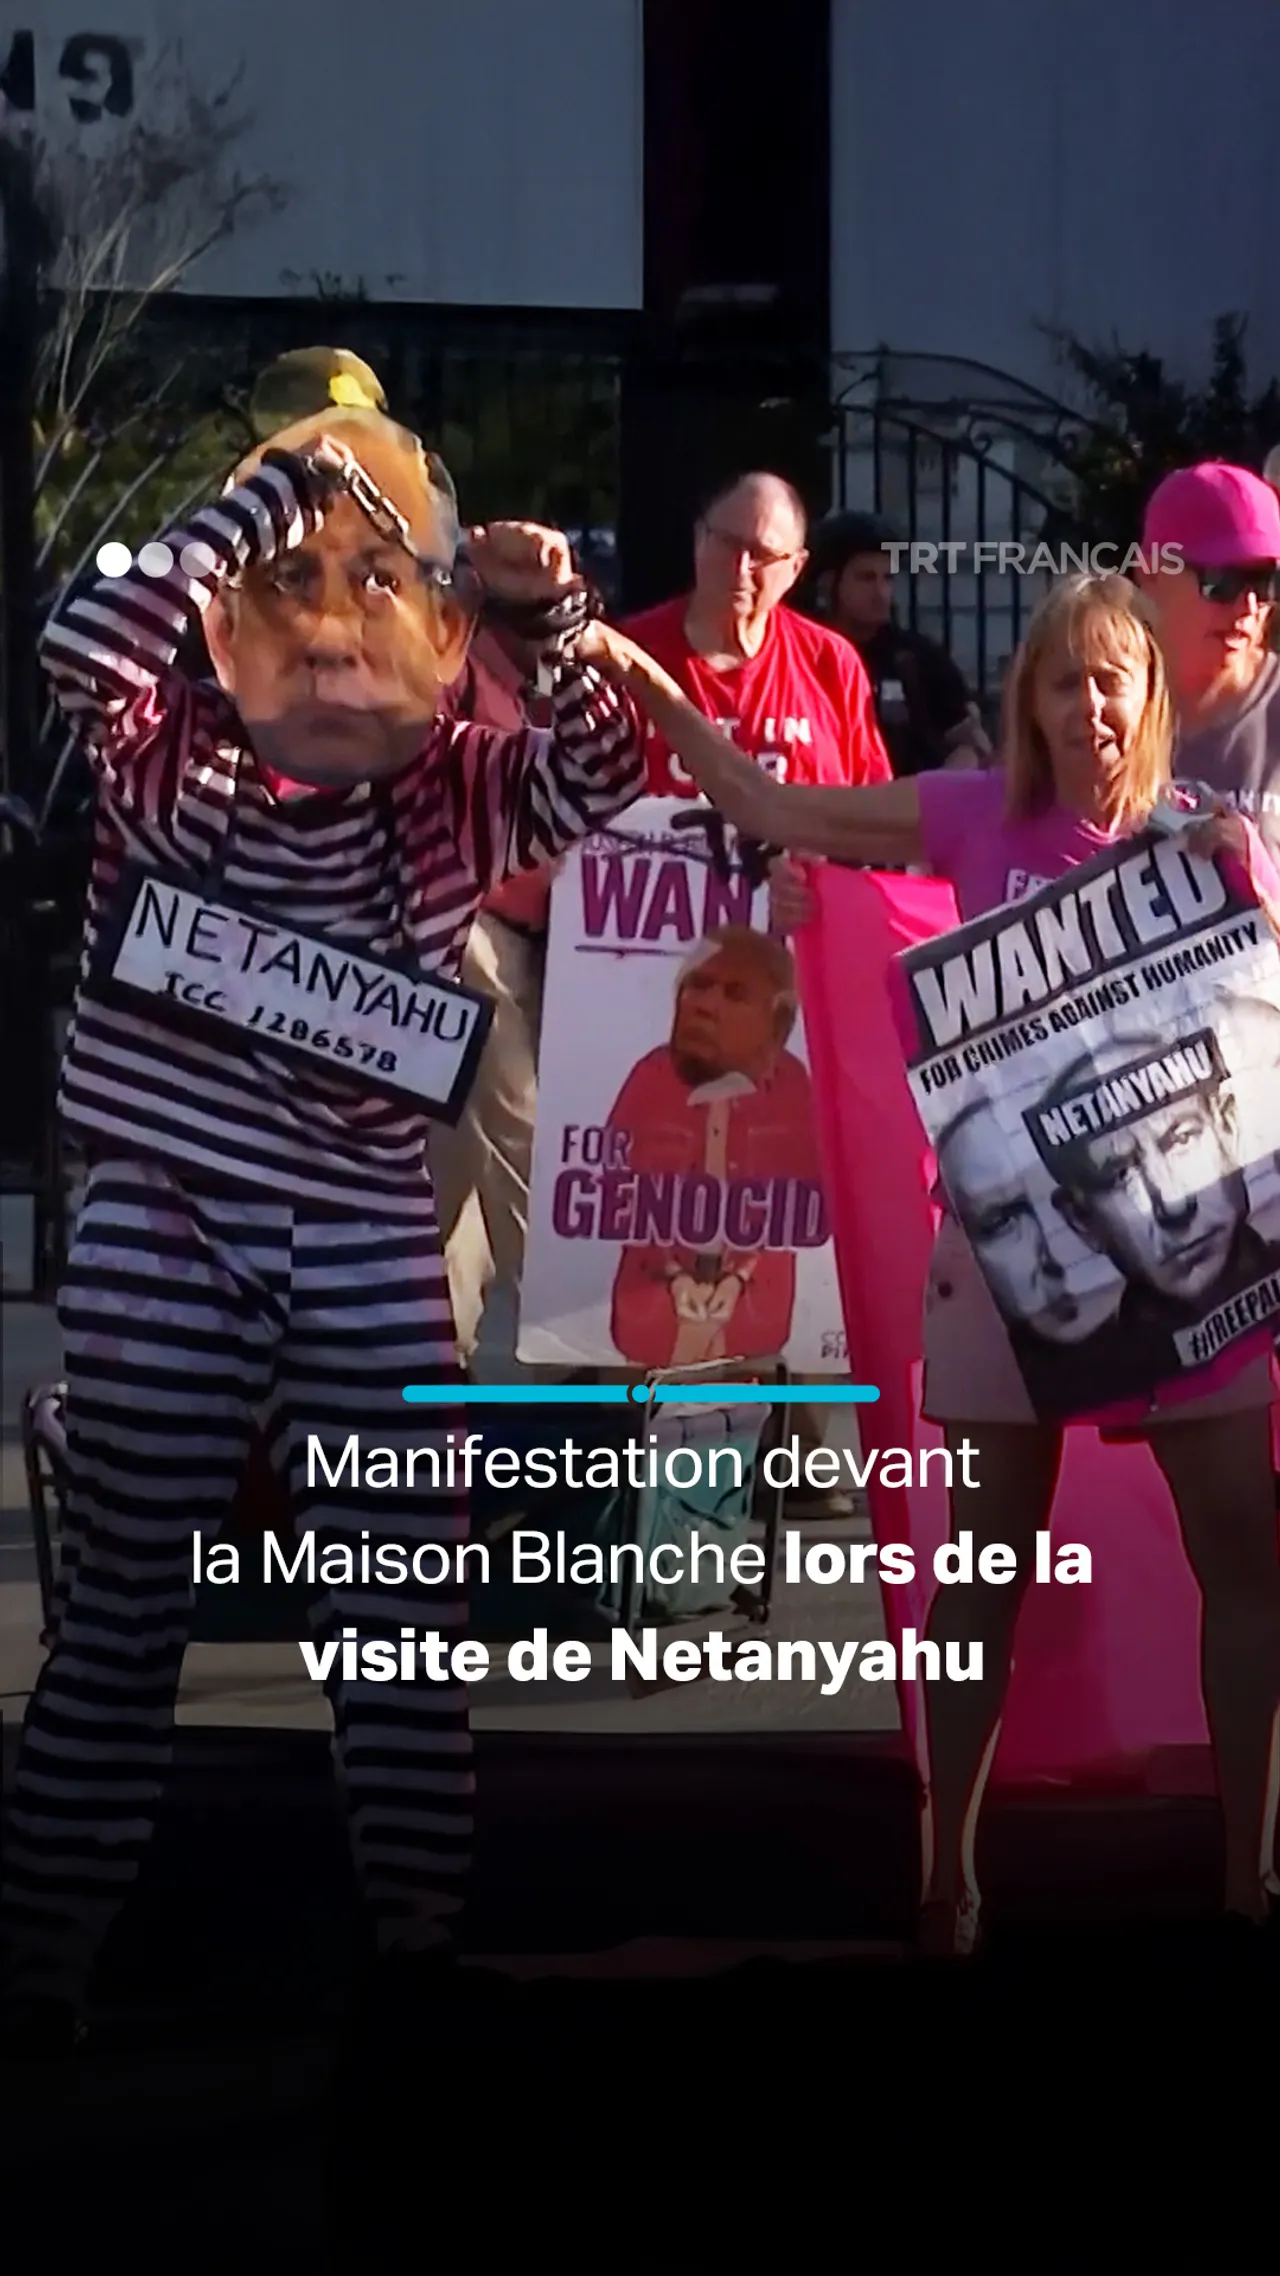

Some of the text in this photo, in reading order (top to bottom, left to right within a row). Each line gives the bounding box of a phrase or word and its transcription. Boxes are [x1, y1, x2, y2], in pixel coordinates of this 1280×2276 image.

[764, 717, 813, 743] IN
[582, 853, 760, 942] WAN
[912, 835, 1227, 1048] WANTED
[136, 883, 468, 1041] NETANYAHU
[165, 970, 228, 1012] ICC
[919, 920, 1261, 1096] FOR CRIMES AGAINST HUMANITY
[1038, 1039, 1213, 1147] NETANYAHU
[561, 1124, 633, 1170] FOR
